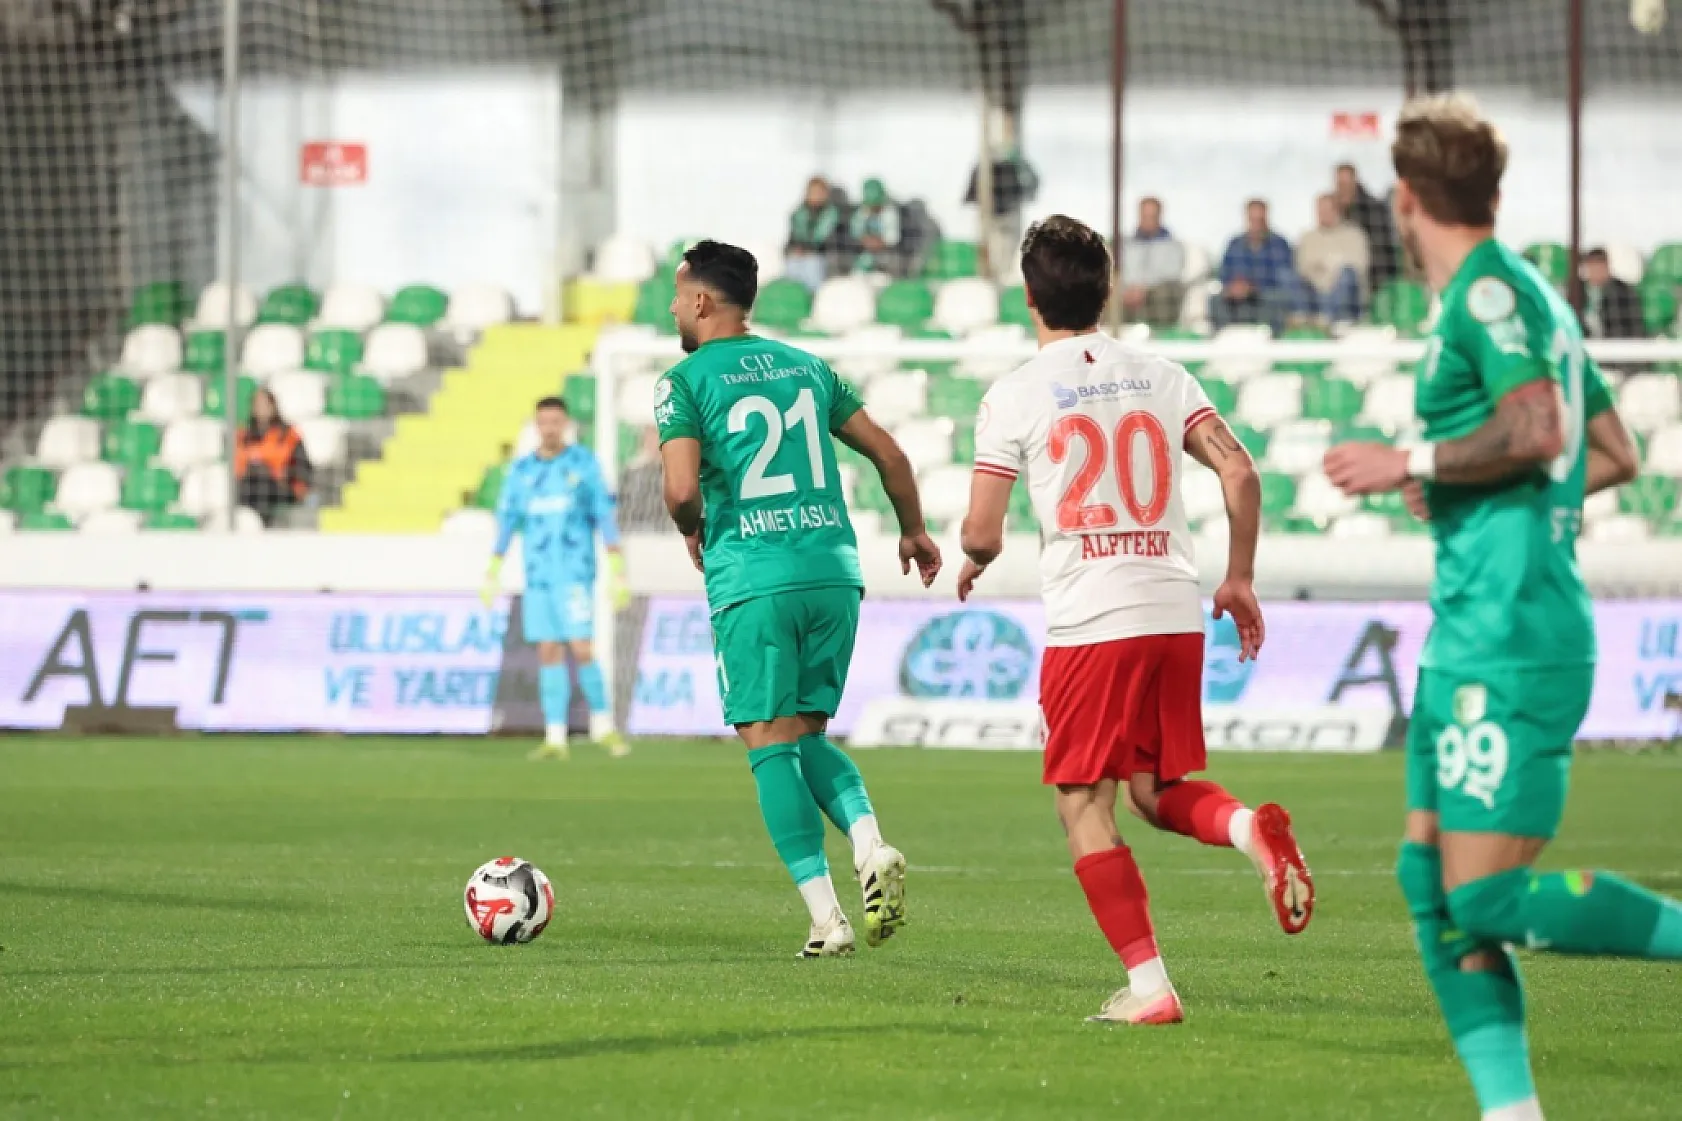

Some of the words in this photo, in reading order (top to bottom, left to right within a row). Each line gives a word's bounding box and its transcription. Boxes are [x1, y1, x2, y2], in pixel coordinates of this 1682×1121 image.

[719, 372, 763, 385] TRAVEL
[763, 365, 810, 382] AGENCY
[740, 352, 774, 372] CIP
[727, 388, 826, 500] 21
[1047, 409, 1173, 531] 20
[740, 508, 797, 540] AHMET
[20, 607, 270, 706] AFT
[1436, 721, 1509, 795] 99
